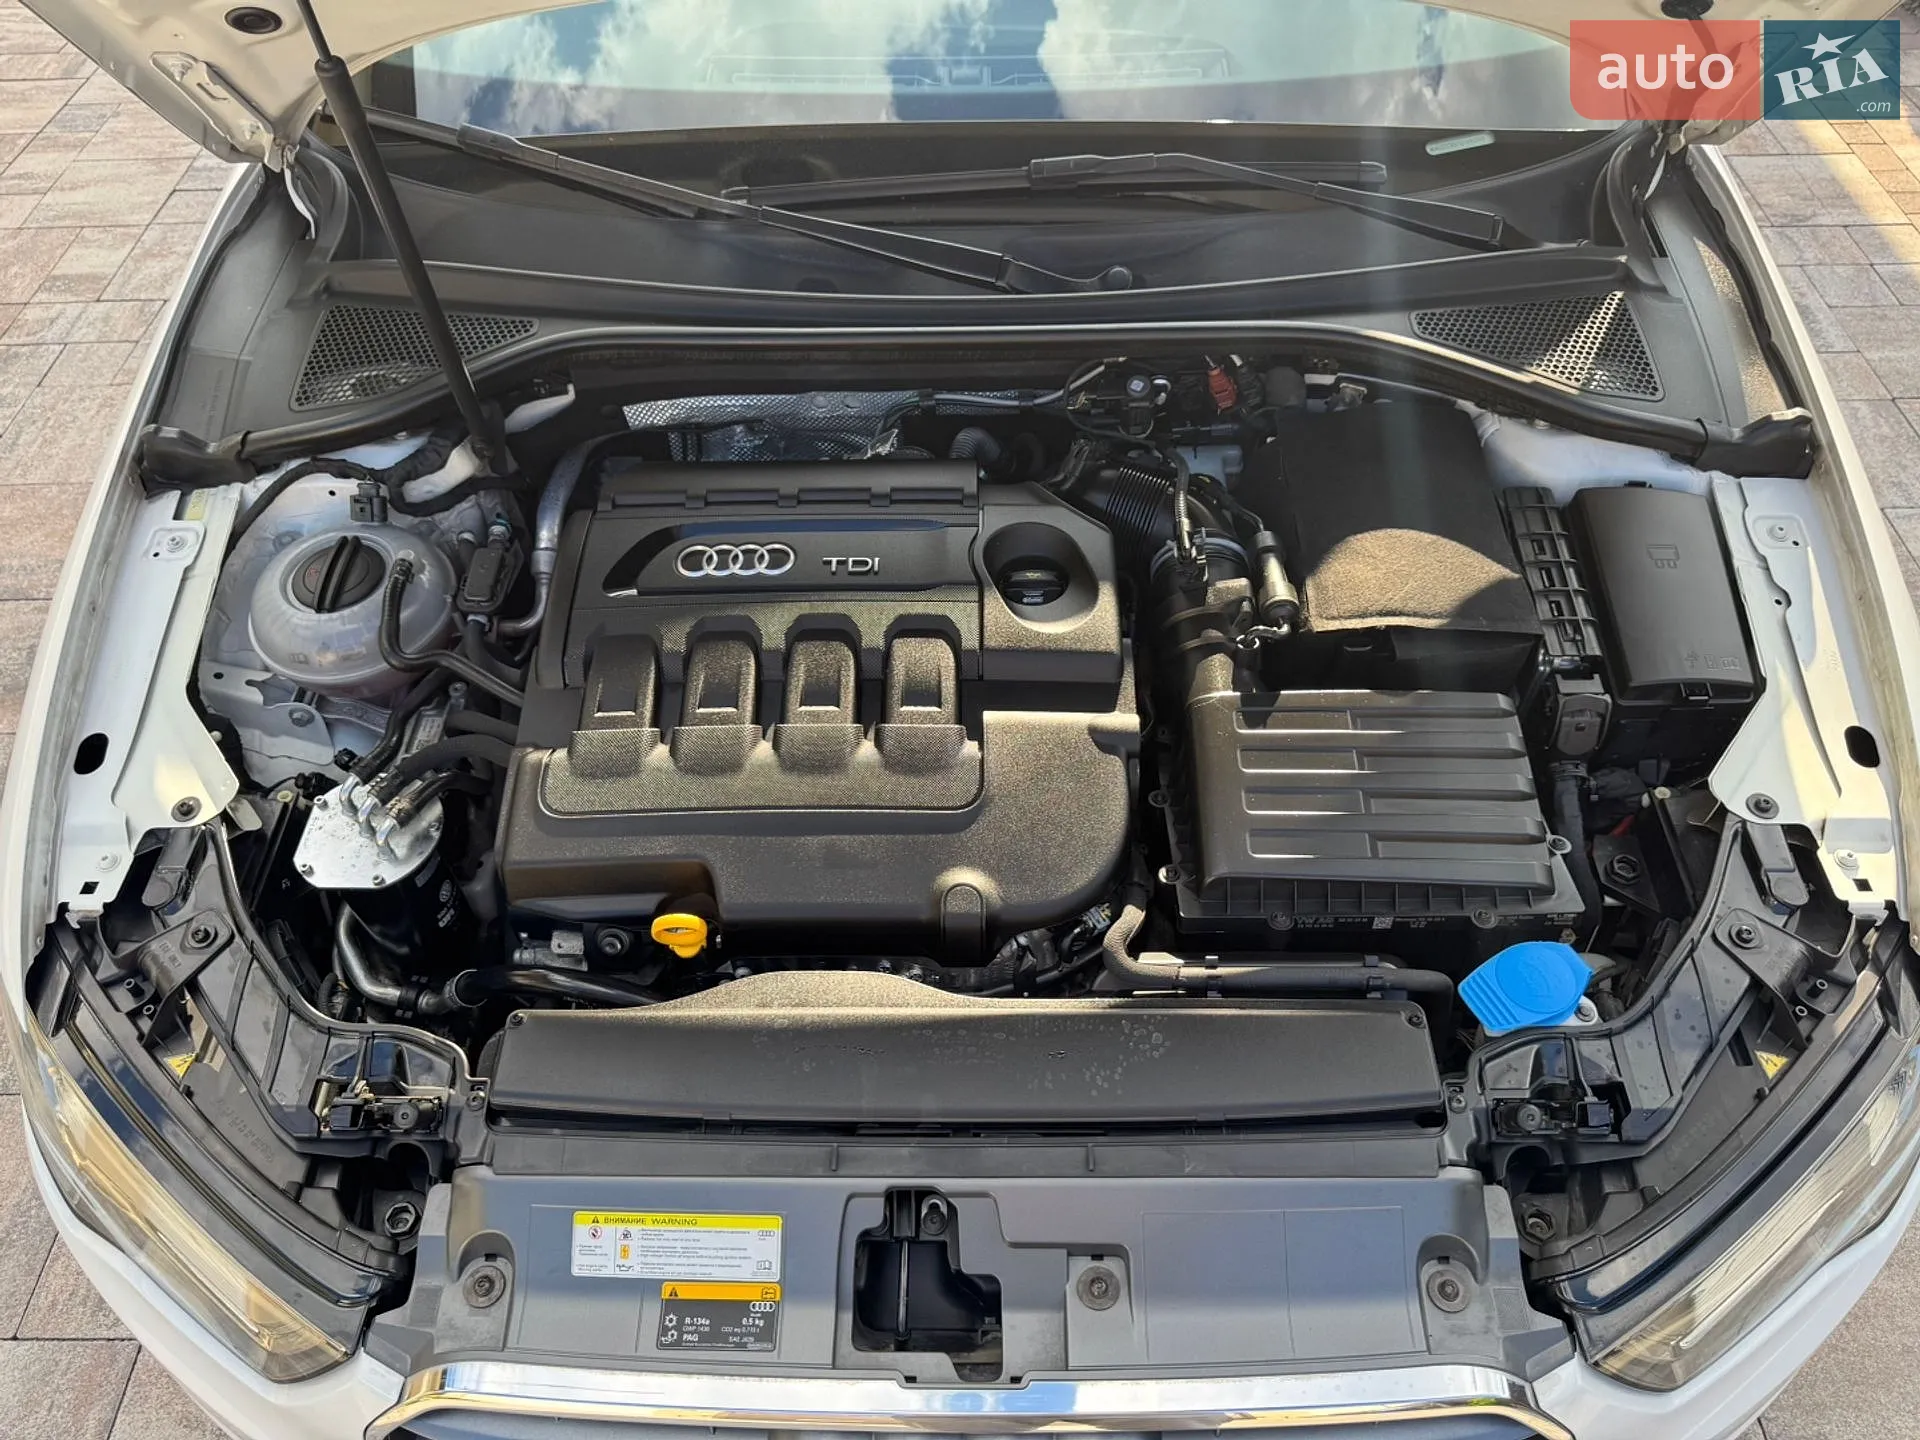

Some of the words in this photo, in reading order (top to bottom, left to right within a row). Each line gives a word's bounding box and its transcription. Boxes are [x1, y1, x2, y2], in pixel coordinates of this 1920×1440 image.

[822, 557, 881, 573] TDI
[603, 1215, 647, 1225] ВНИМАНИЕ
[650, 1217, 698, 1226] WARNING
[685, 1317, 711, 1325] R-134a
[683, 1333, 699, 1341] PAG
